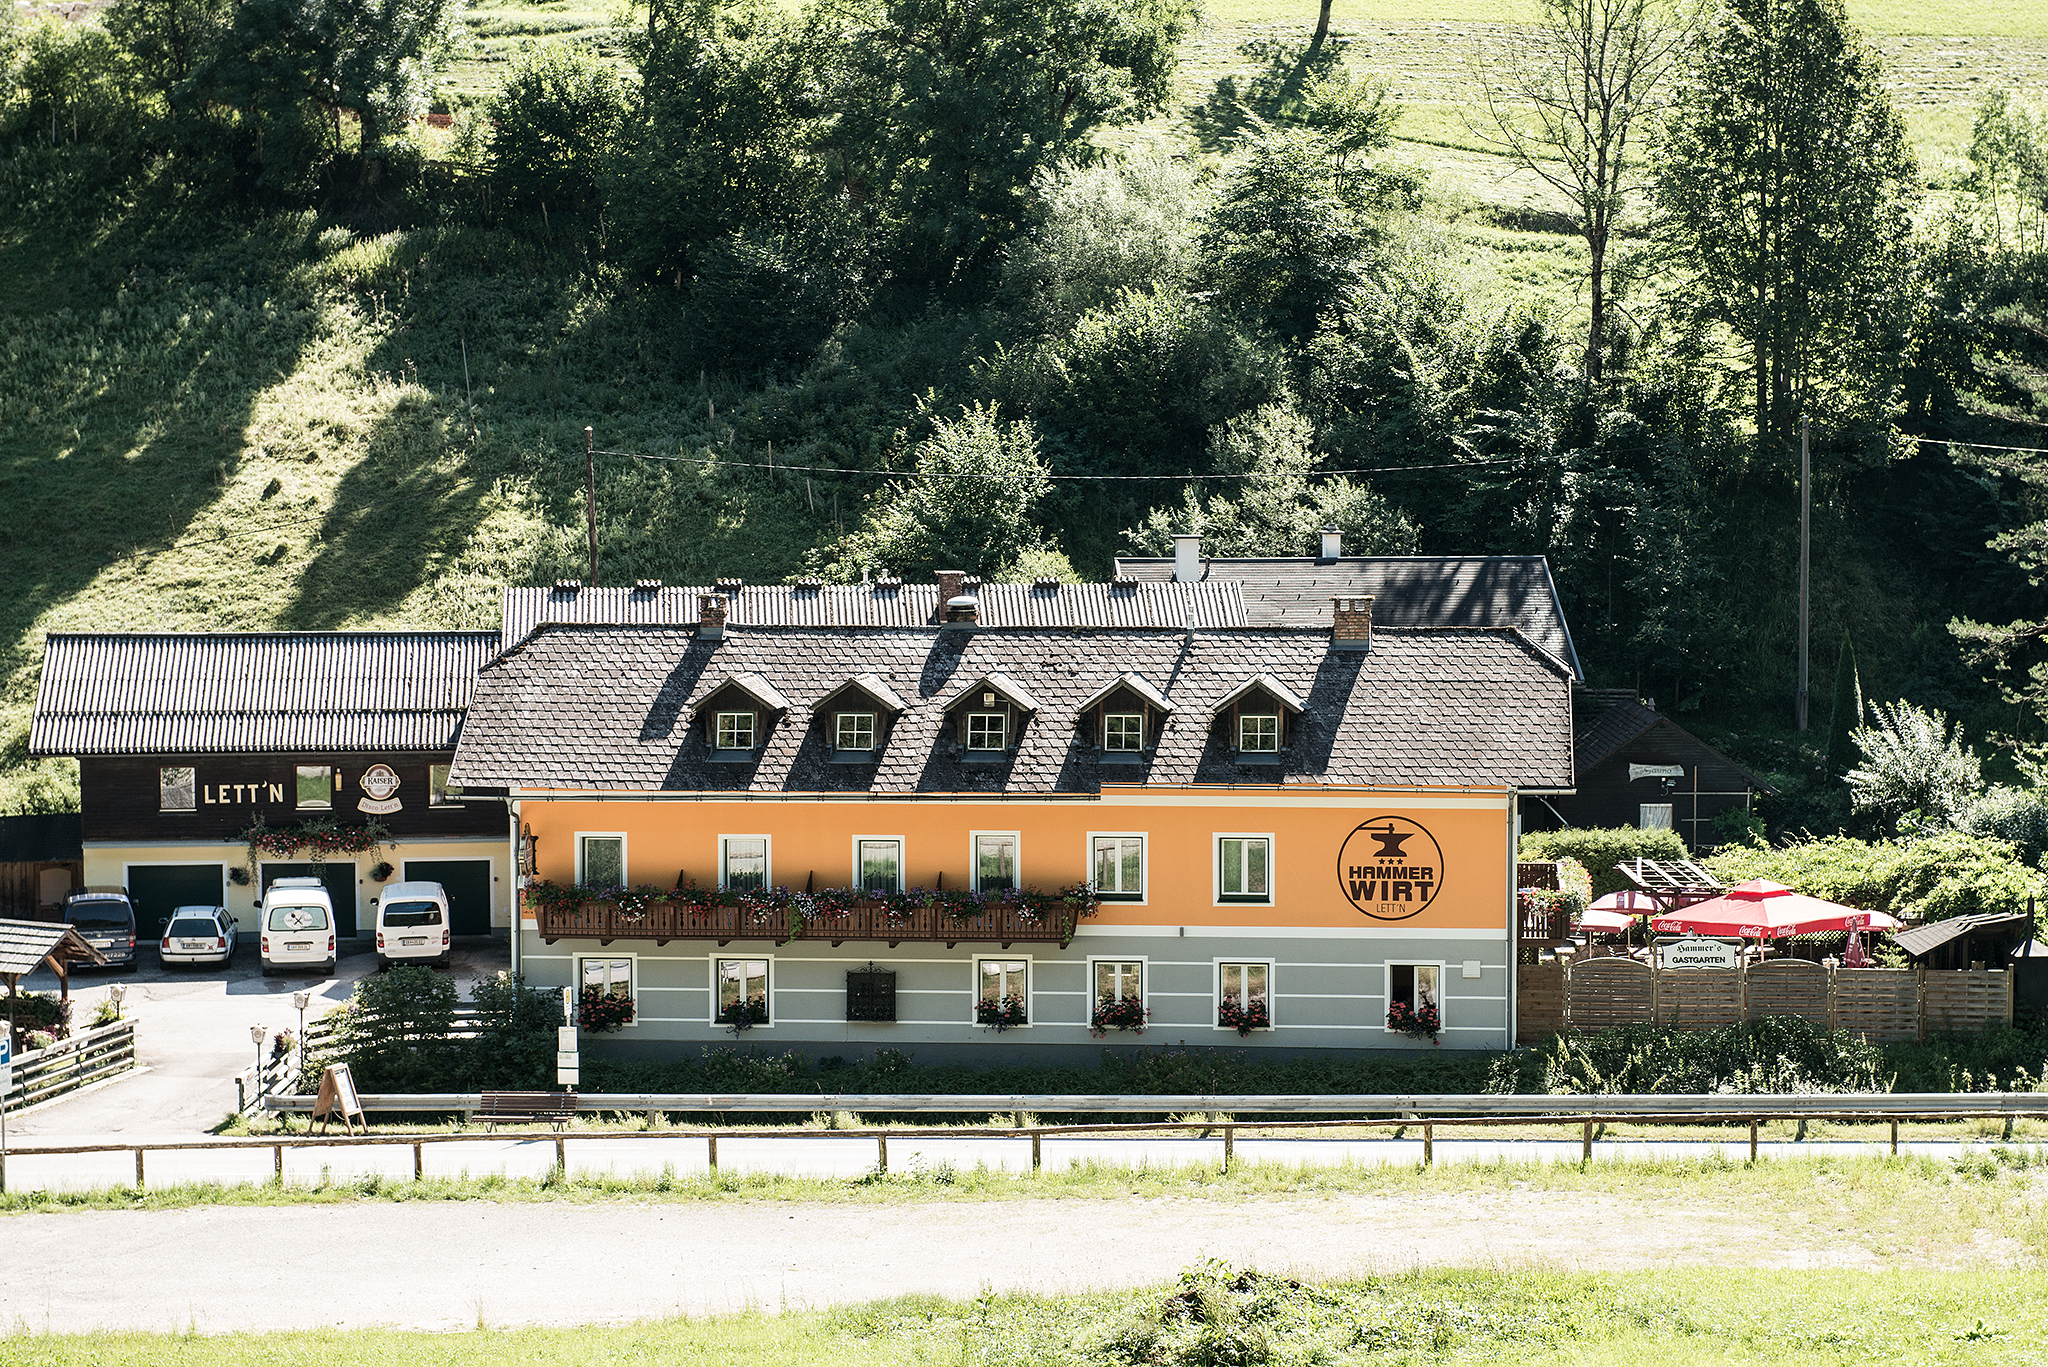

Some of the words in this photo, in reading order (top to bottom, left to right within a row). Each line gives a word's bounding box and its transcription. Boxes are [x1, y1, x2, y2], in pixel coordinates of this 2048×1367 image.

[367, 777, 393, 785] KAISER
[204, 780, 283, 804] LETT'N
[361, 801, 379, 811] Disco
[1349, 866, 1433, 879] HAMMER
[1349, 880, 1434, 901] WIRT
[1676, 944, 1722, 953] Hammer's
[1672, 956, 1726, 964] GASTGARTEN
